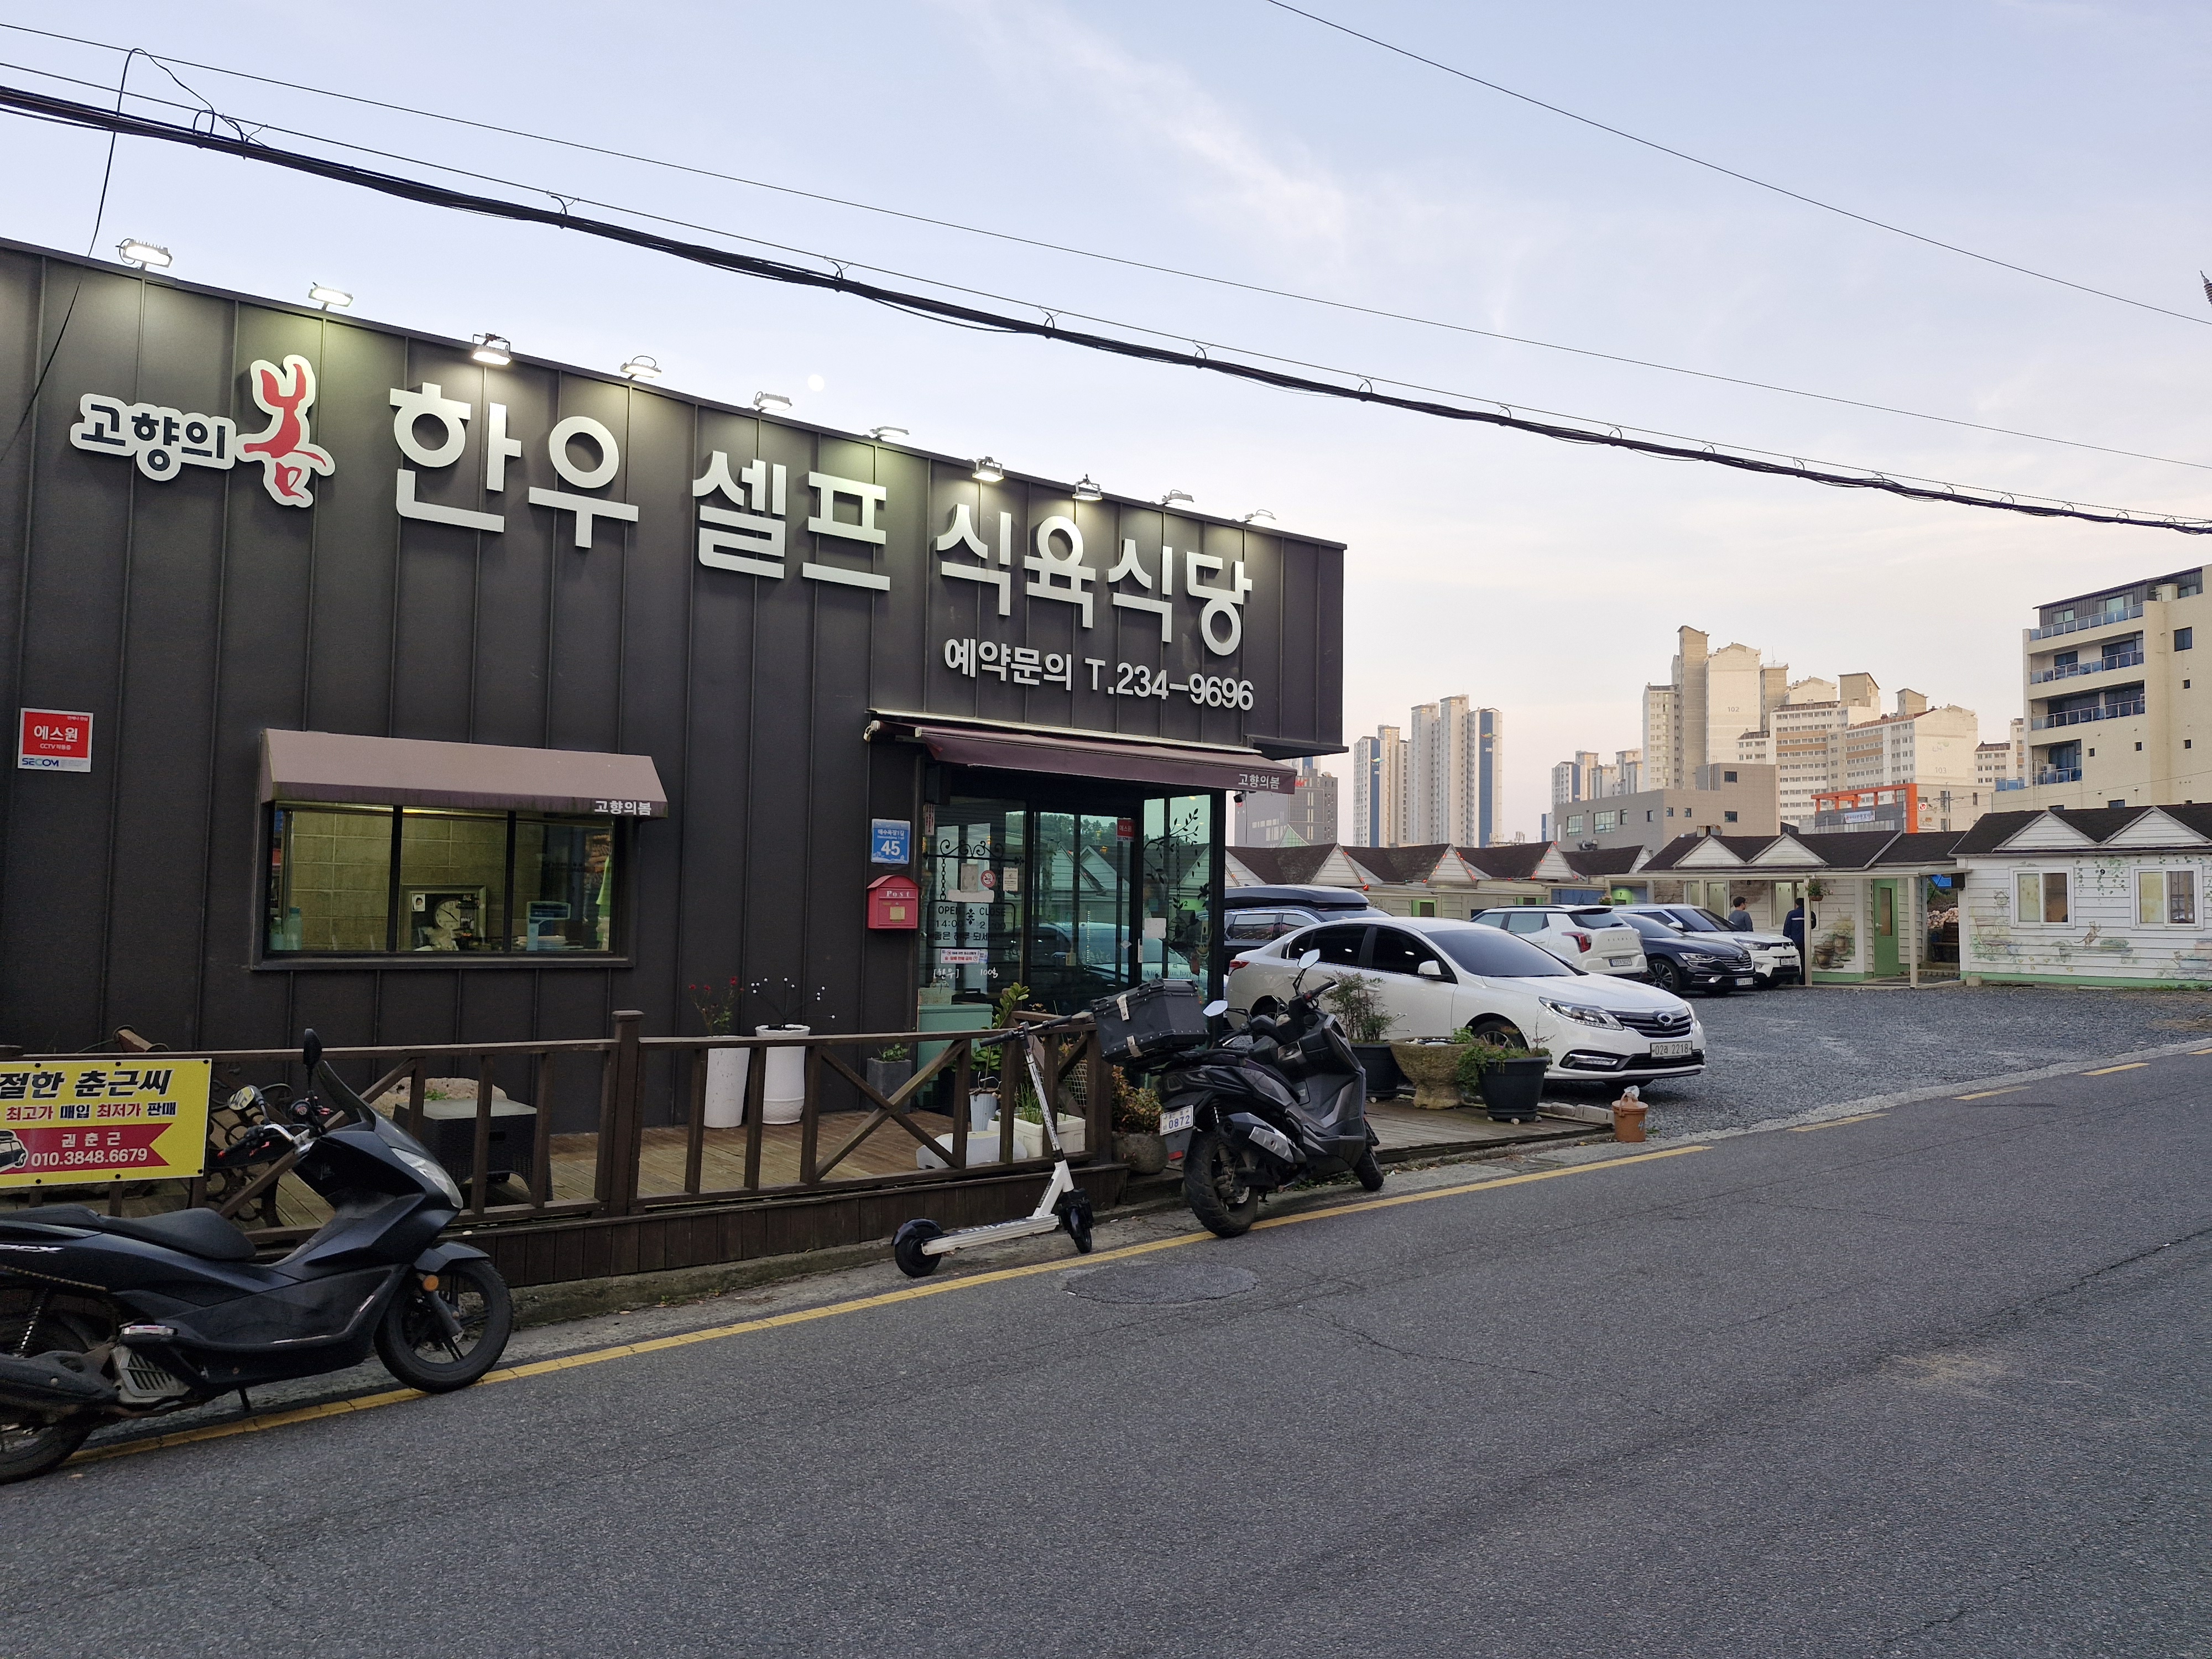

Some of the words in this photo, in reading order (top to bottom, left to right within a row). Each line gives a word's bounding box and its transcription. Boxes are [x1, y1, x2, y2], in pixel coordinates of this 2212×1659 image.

[81, 404, 227, 473] 고향의
[243, 362, 328, 499] 봄
[389, 383, 639, 548] 한우
[693, 451, 890, 591] 셀프
[936, 504, 1253, 656] 식육식당
[944, 638, 1073, 691] 예약문의
[1084, 658, 1254, 712] T.234-9696
[34, 725, 78, 742] 에스원
[22, 758, 59, 766] SECOM
[1238, 773, 1280, 790] 고향의봄
[594, 800, 651, 816] 고향의봄
[880, 840, 900, 855] 45
[938, 905, 961, 915] OPEN
[979, 907, 1006, 916] CLOSE
[936, 920, 963, 928] 14:00
[979, 921, 1006, 930] 2:00
[935, 931, 951, 941] 좋은
[1655, 1045, 1668, 1055] 02라
[1672, 1044, 1688, 1054] 2218
[75, 1069, 174, 1098] 춘근씨
[6, 1107, 54, 1121] 최고가
[60, 1105, 90, 1119] 매입
[97, 1104, 141, 1118] 최저가
[147, 1102, 176, 1115] 판매
[1168, 1115, 1190, 1129] 0872
[31, 1148, 148, 1167] 010.3848.6679
